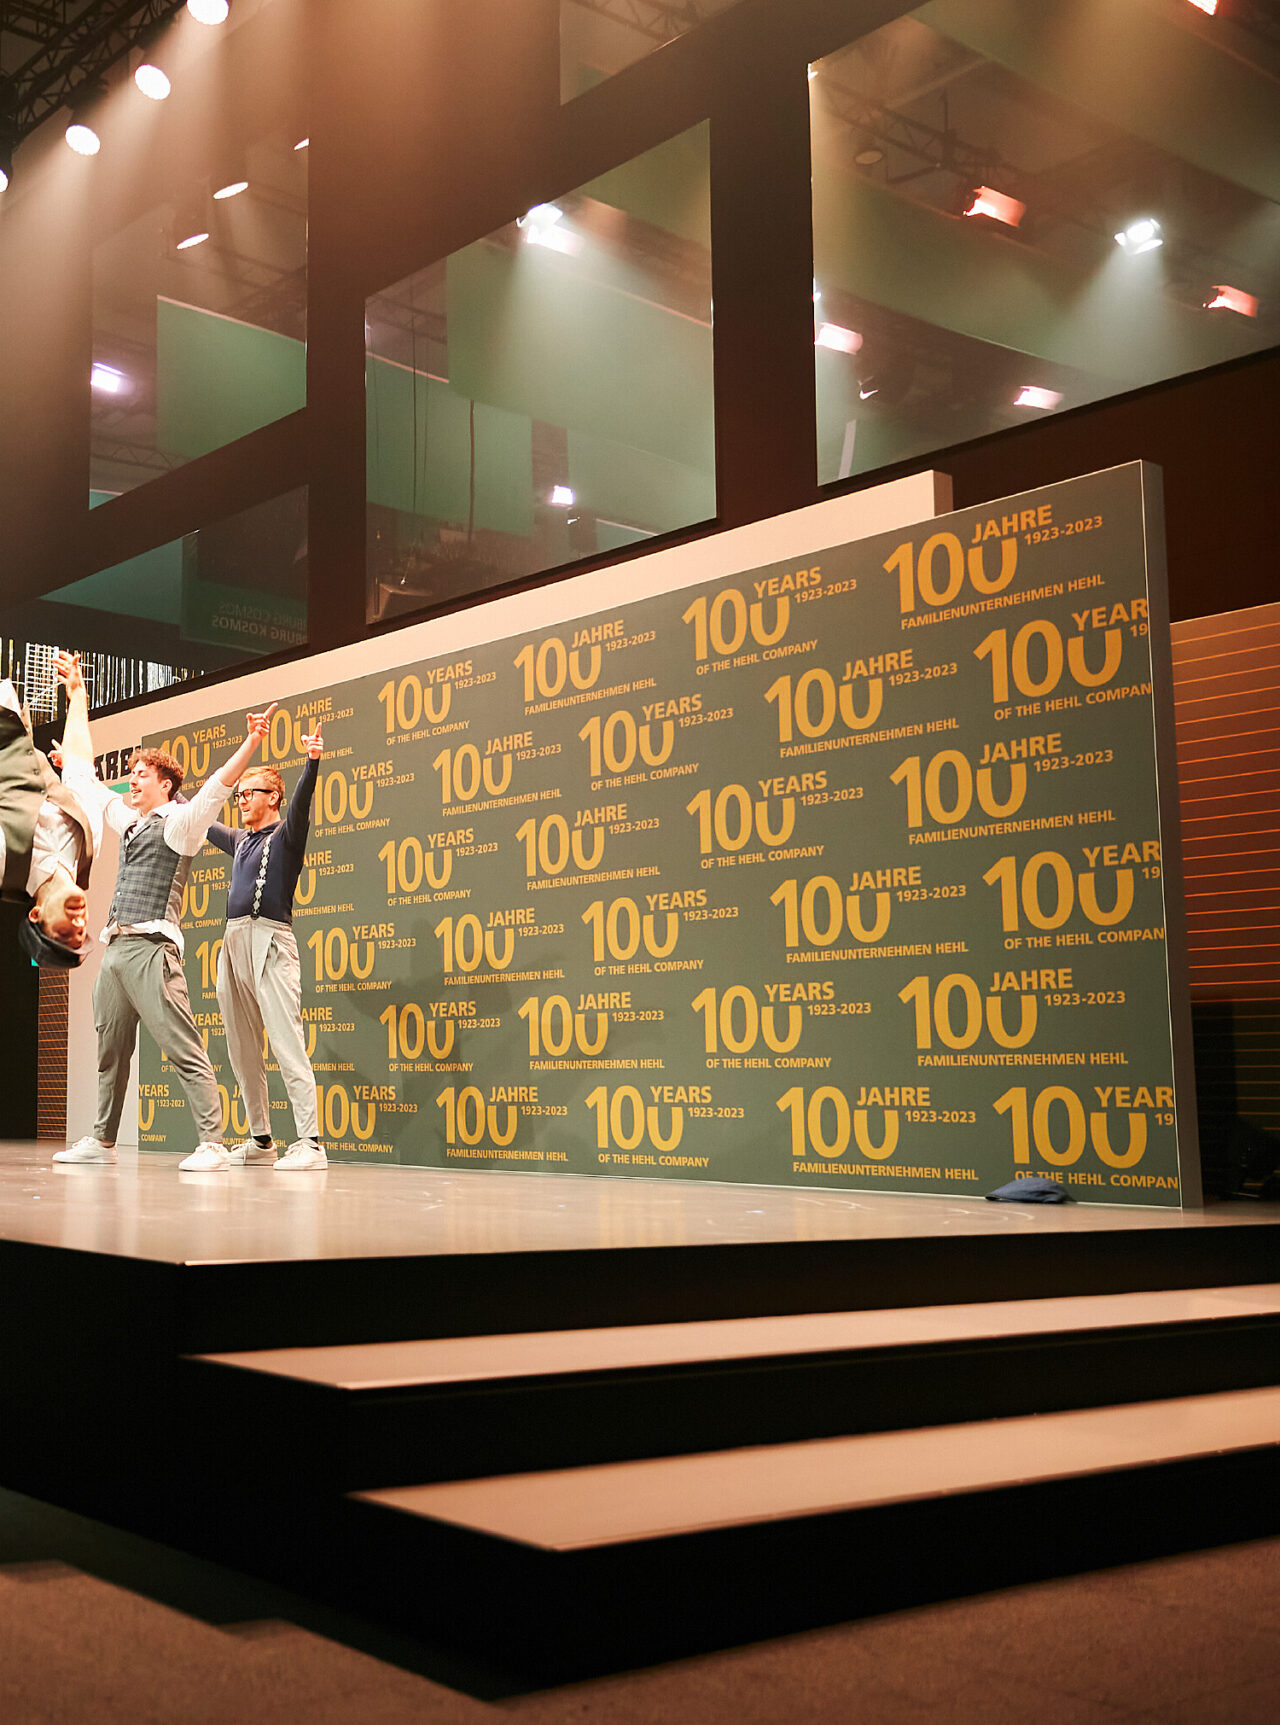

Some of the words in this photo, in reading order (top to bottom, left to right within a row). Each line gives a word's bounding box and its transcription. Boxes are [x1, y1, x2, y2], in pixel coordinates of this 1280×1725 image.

[972, 504, 1052, 544] JAHRE
[1024, 515, 1103, 545] 1923-2023
[754, 566, 822, 599] YEARS
[795, 579, 857, 603] 1923-2023
[901, 583, 1064, 630] FAMILIENUNTERNEHMEN
[1068, 574, 1105, 593] HEHL
[572, 620, 624, 649] JAHRE
[605, 631, 656, 652] 1923-2023
[696, 664, 710, 676] OF
[712, 659, 731, 672] THE
[733, 653, 760, 668] HEHL
[762, 640, 818, 661] COMPANY
[843, 649, 913, 681] JAHRE
[427, 660, 473, 685] YEARS
[454, 671, 497, 689] 1923-2023
[889, 662, 958, 686] 1923-2023
[524, 684, 631, 716] FAMILIENUNTERNEHMEN
[632, 678, 657, 691] HEHL
[296, 700, 332, 719] JAHRE
[642, 694, 702, 722] YEARS
[679, 707, 734, 728] 1923-2023
[994, 707, 1012, 721] OF
[1015, 702, 1041, 717] THE
[1045, 696, 1082, 712] HEHL
[193, 724, 226, 744] YEARS
[212, 736, 243, 749] 1923-2023
[485, 731, 533, 756] JAHRE
[780, 724, 924, 758] FAMILIENUNTERNEHMEN
[926, 718, 959, 733] HEHL
[516, 743, 562, 761] 1923-2023
[980, 733, 1062, 765] JAHRE
[352, 760, 393, 781] YEARS
[1034, 750, 1113, 772] 1923-2023
[377, 772, 415, 787] 1923-2023
[758, 771, 827, 798] YEARS
[442, 792, 539, 817] FAMILIENUNTERNEHMEN
[541, 788, 561, 800] HEHL
[800, 787, 864, 806] 1923-2023
[574, 803, 627, 828] JAHRE
[609, 818, 660, 834] 1923-2023
[909, 815, 1074, 845] FAMILIENUNTERNEHMEN
[1077, 810, 1116, 825] HEHL
[427, 828, 474, 849] YEARS
[456, 842, 499, 857] 1923-2023
[701, 858, 715, 869] OF
[717, 856, 737, 867] THE
[738, 853, 766, 865] HEHL
[768, 845, 825, 862] COMPANY
[192, 866, 225, 883] YEARS
[319, 864, 354, 876] 1923-2023
[527, 869, 634, 890] FAMILIENUNTERNEHMEN
[636, 866, 660, 878] HEHL
[849, 866, 922, 892] JAHRE
[646, 889, 707, 911] YEARS
[896, 885, 967, 902] 1923-2023
[487, 907, 535, 928] JAHRE
[684, 907, 739, 921] 1923-2023
[352, 922, 395, 940] YEARS
[518, 924, 565, 937] 1923-2023
[378, 938, 417, 950] 1923-2023
[1004, 938, 1022, 950] OF
[1026, 936, 1052, 948] THE
[1056, 933, 1094, 947] HEHL
[786, 944, 932, 964] FAMILIENUNTERNEHMEN
[935, 941, 969, 954] HEHL
[444, 970, 544, 985] FAMILIENUNTERNEHMEN
[544, 969, 565, 979] HEHL
[990, 968, 1073, 992] JAHRE
[577, 992, 632, 1011] JAHRE
[765, 981, 835, 1003] YEARS
[1044, 991, 1126, 1006] 1923-2023
[429, 1001, 477, 1018] YEARS
[612, 1010, 665, 1022] 1923-2023
[808, 1002, 872, 1016] 1923-2023
[319, 1022, 355, 1032] 1923-2023
[458, 1017, 501, 1029] 1923-2023
[530, 1059, 638, 1070] FAMILIENUNTERNEHMEN
[640, 1058, 665, 1069] HEHL
[706, 1058, 720, 1069] OF
[721, 1058, 742, 1069] THE
[743, 1058, 772, 1069] HEHL
[774, 1057, 831, 1068] COMPANY
[918, 1053, 1086, 1067] FAMILIENUNTERNEHMEN
[1090, 1052, 1129, 1065] HEHL
[353, 1085, 396, 1101] YEARS
[489, 1086, 538, 1103] JAHRE
[648, 1086, 712, 1108] YEARS
[857, 1087, 931, 1107] JAHRE
[379, 1103, 418, 1113] 1923-2023
[521, 1105, 568, 1116] 1923-2023
[687, 1107, 745, 1119] 1923-2023
[905, 1110, 976, 1123] 1923-2023
[446, 1148, 545, 1161] FAMILIENUNTERNEHMEN
[546, 1152, 568, 1162] HEHL
[598, 1154, 610, 1163] OF
[612, 1154, 630, 1164] THE
[631, 1155, 657, 1165] HEHL
[658, 1156, 710, 1167] COMPANY
[793, 1162, 941, 1179] FAMILIENUNTERNEHMEN
[944, 1168, 979, 1181] HEHL
[1068, 1173, 1106, 1186] HEHL
